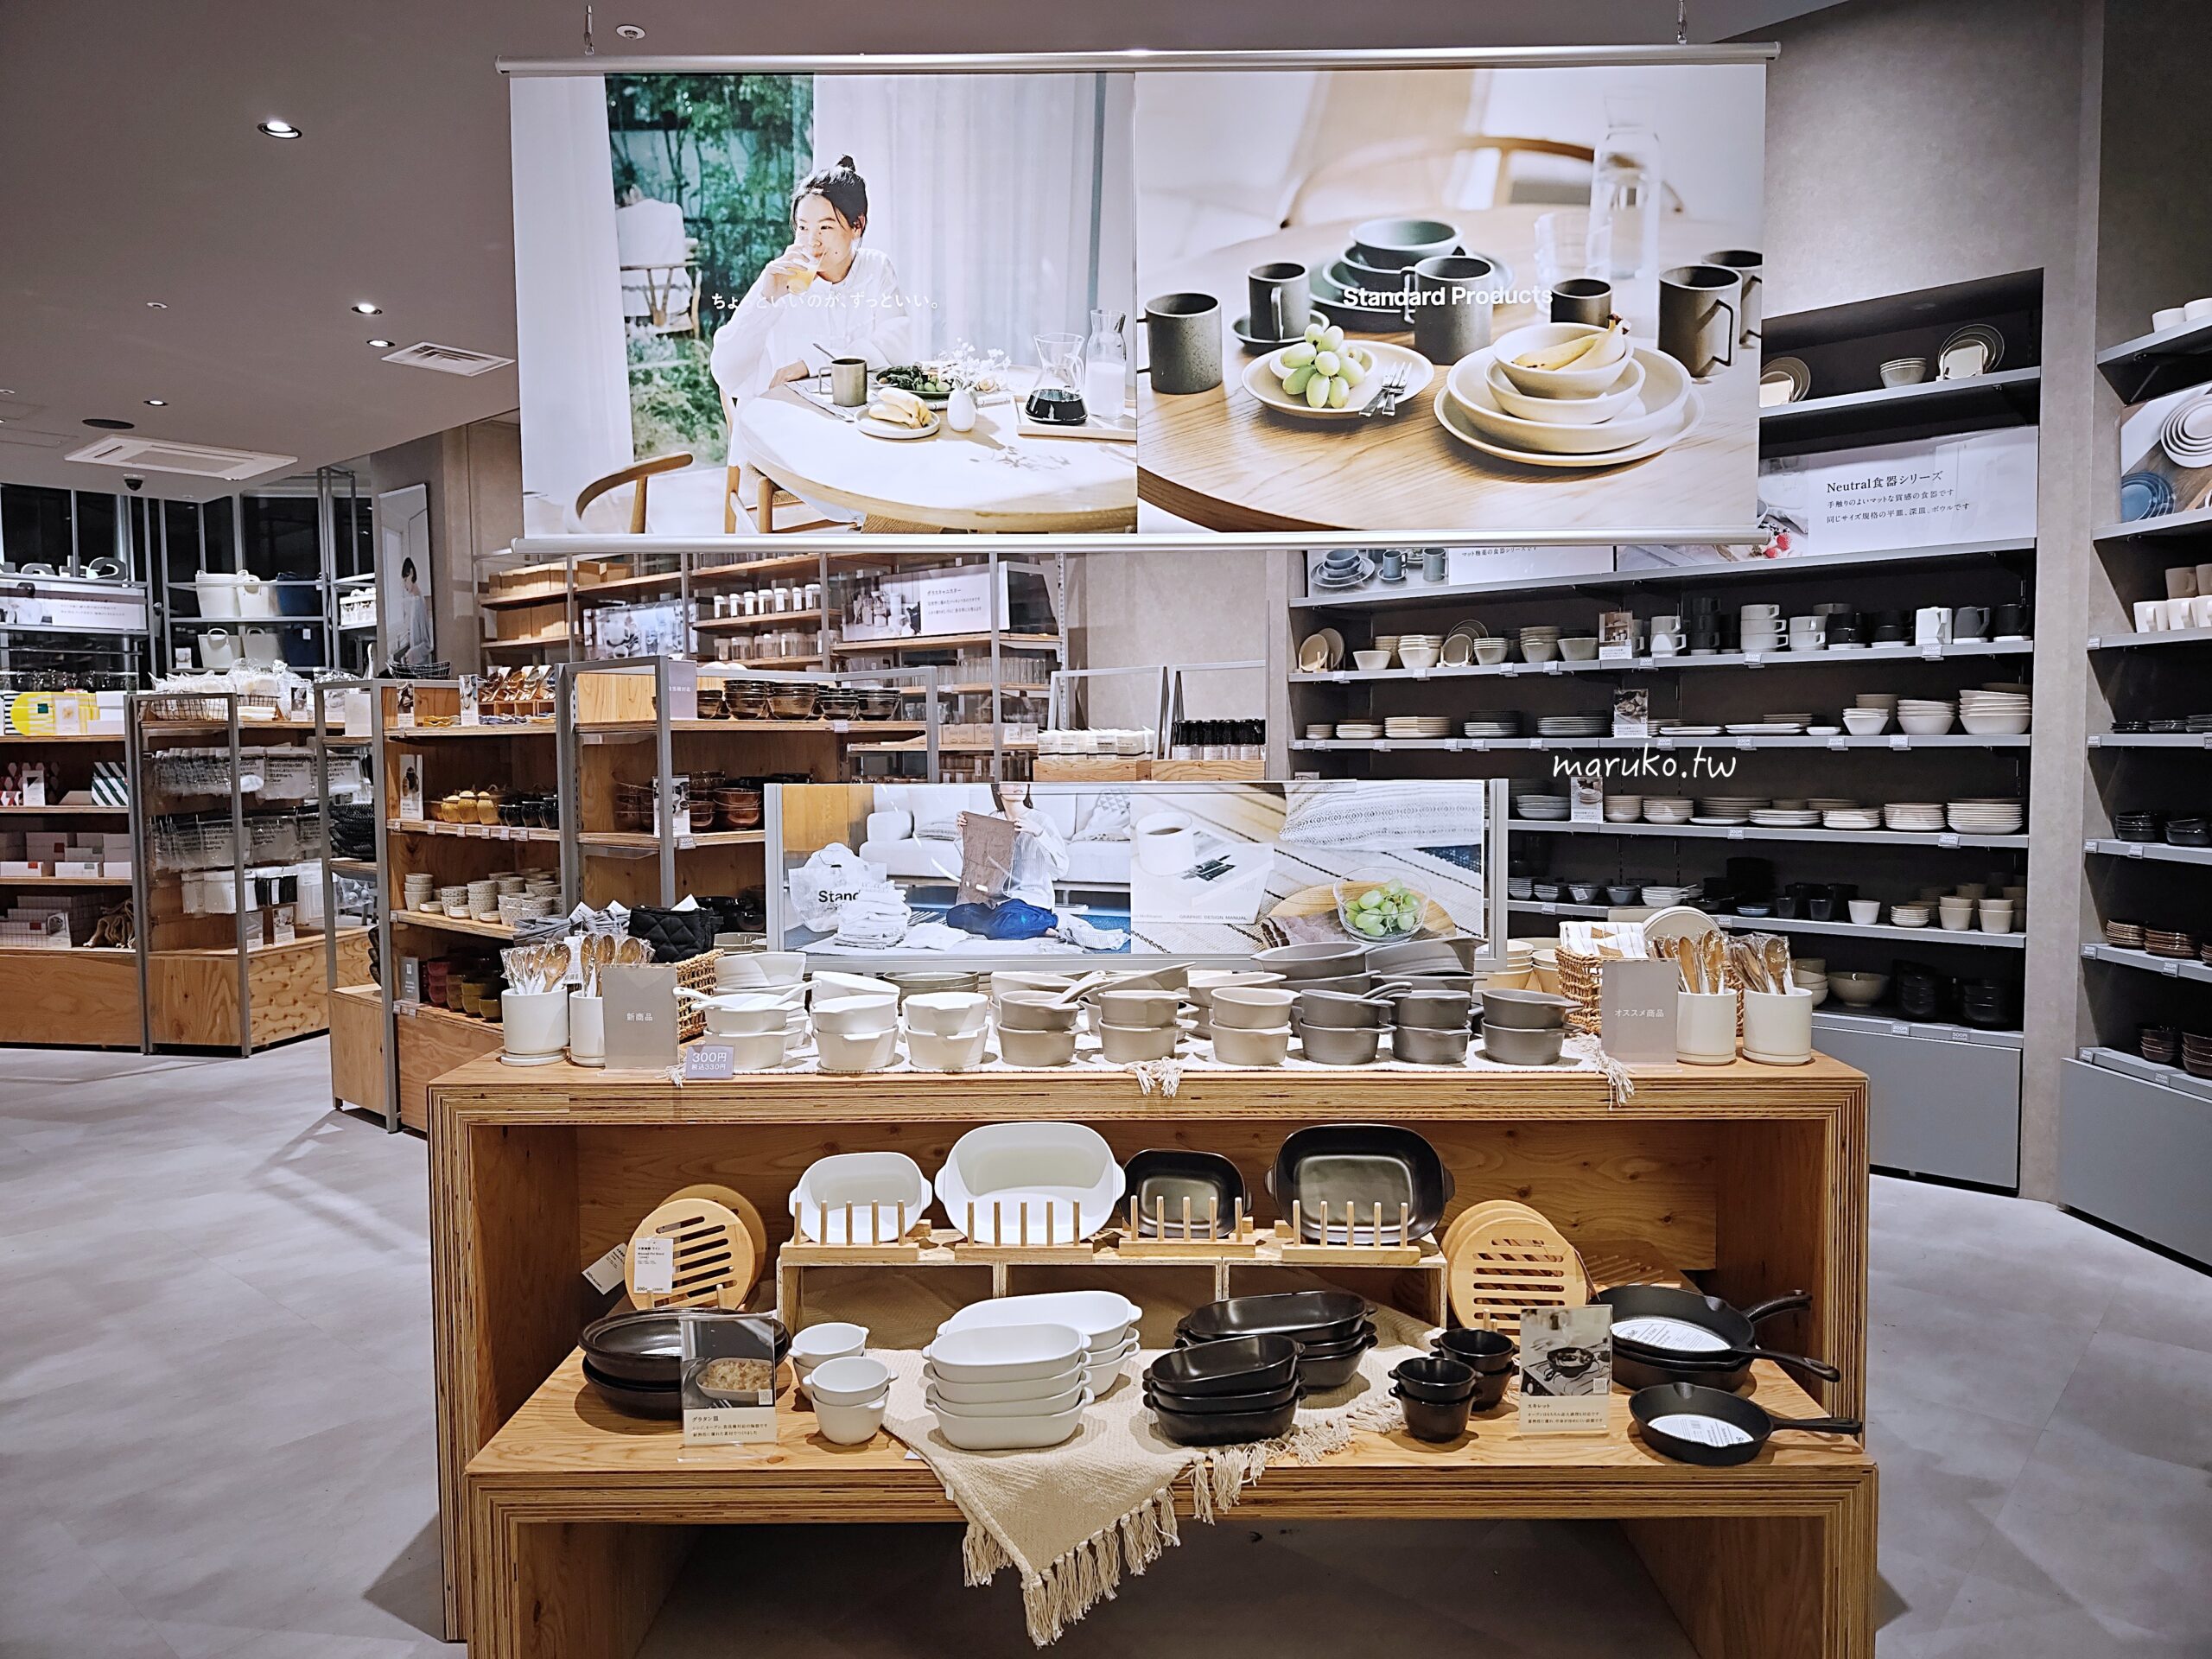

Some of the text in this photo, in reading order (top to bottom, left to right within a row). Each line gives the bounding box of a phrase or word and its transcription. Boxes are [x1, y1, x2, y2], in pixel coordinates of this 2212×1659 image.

[711, 292, 938, 310] ちょといいのが、ずっといい。
[1343, 285, 1553, 307] Standard Products
[1827, 470, 1943, 493] Neutral食器シリーズ
[626, 1013, 653, 1021] 新商品
[1614, 1008, 1664, 1018] オススメ商品
[691, 1052, 727, 1063] 300円
